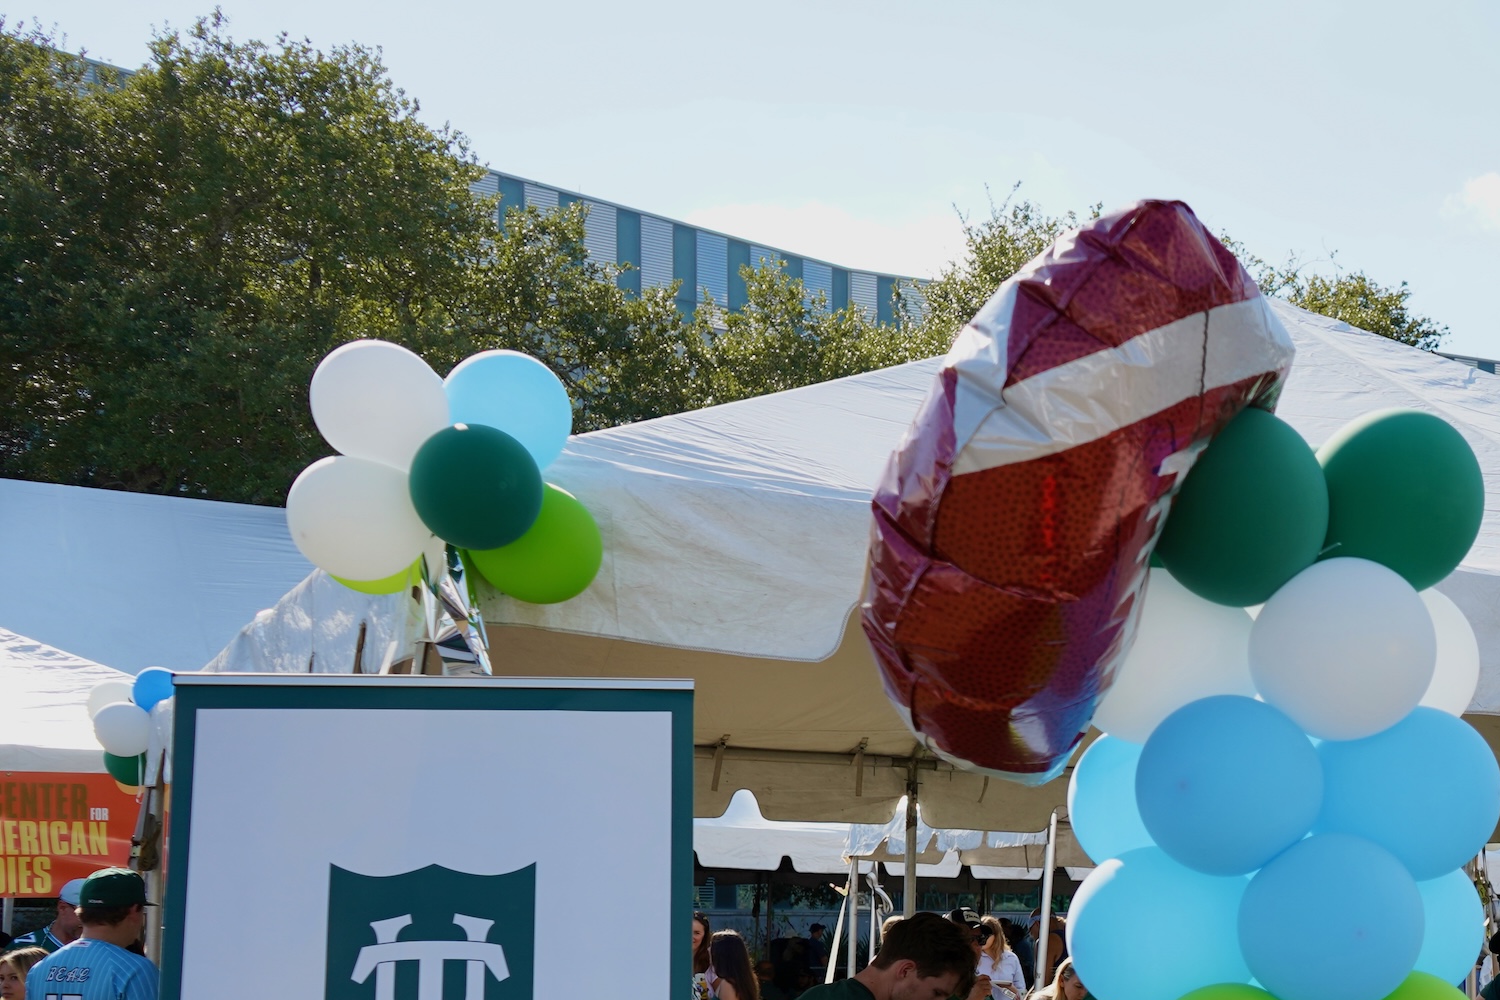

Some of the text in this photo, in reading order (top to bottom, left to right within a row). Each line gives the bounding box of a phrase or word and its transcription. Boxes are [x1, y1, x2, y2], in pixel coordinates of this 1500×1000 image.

[0, 781, 109, 821] ENTER FOR
[0, 820, 109, 856] ERICAN
